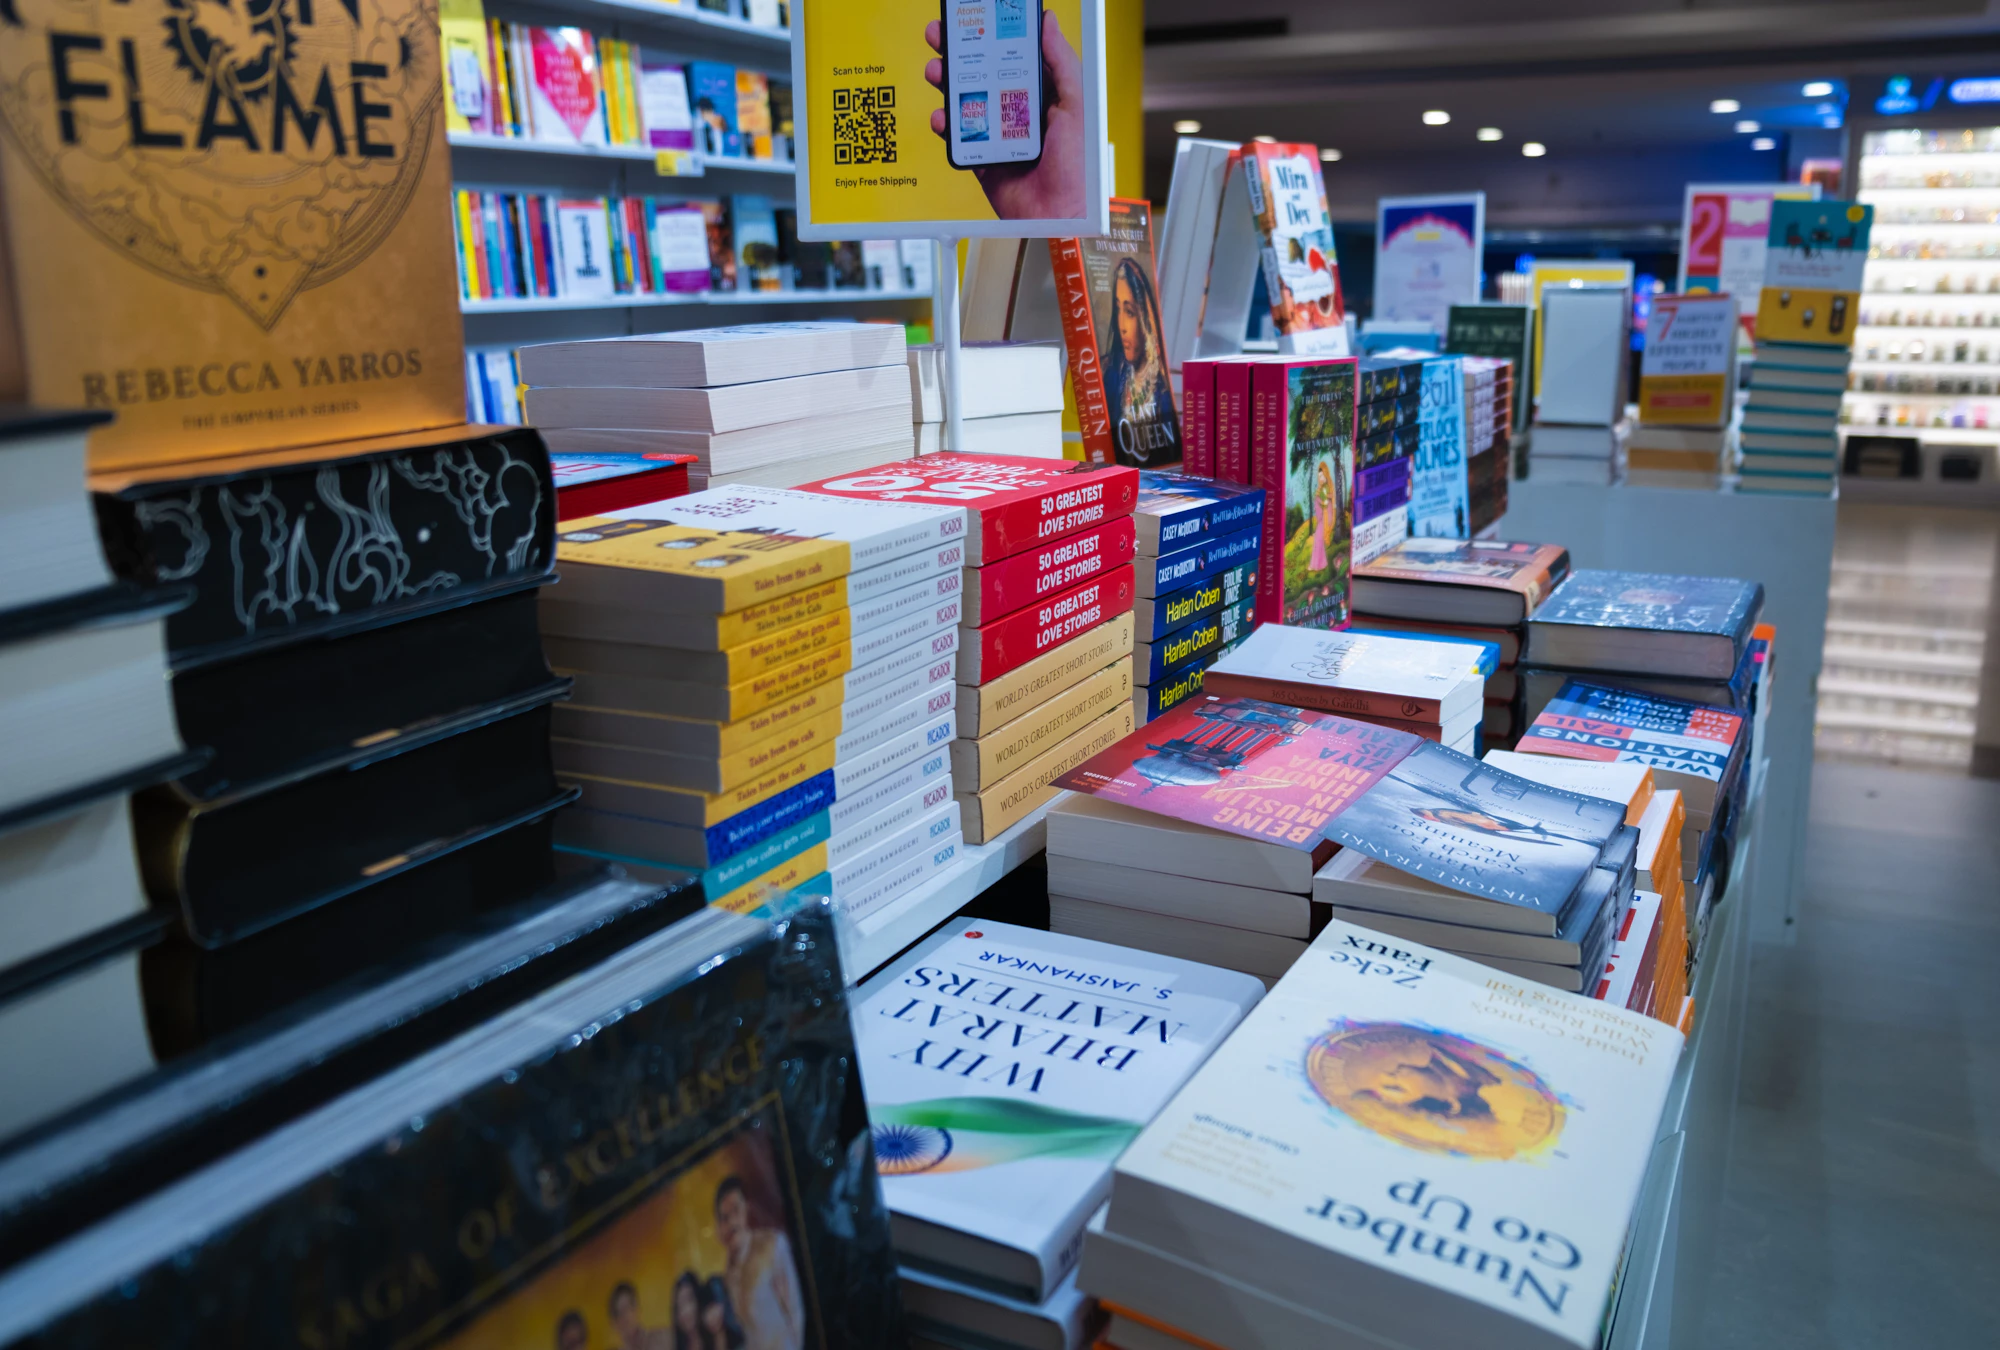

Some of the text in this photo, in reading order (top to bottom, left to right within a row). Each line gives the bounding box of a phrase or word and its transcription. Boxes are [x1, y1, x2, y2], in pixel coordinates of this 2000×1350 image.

[956, 6, 986, 16] Atomic
[958, 17, 984, 27] Habits
[832, 64, 885, 76] Scan to shop
[47, 31, 397, 158] FLAME
[961, 101, 986, 111] SILENT
[1001, 92, 1028, 102] IT ENDS
[1001, 102, 1020, 112] WITH
[962, 110, 986, 119] PATIENT
[835, 176, 917, 188] Enjoy Free Shipping
[1276, 165, 1309, 190] Mira
[1287, 202, 1311, 227] Dev
[1065, 272, 1091, 335] LAST
[83, 349, 422, 406] REBECCA YARROS
[1077, 346, 1109, 436] QUEEN
[1130, 402, 1157, 423] LAST
[1220, 392, 1229, 441] CHITRA
[1256, 392, 1265, 442] CHITRA
[1118, 417, 1176, 463] QUEEN
[1231, 393, 1240, 472] THE FOREST
[1041, 483, 1104, 515] 50 GREATEST
[1265, 393, 1277, 596] THE FOREST ENCHANTMENTS
[940, 516, 962, 537] PICADOR
[1038, 503, 1104, 538] LOVE STORIES
[1162, 523, 1177, 541] CASEY
[1355, 516, 1391, 551] GUEST LIST
[854, 530, 931, 560] TOSHIKAZU KAWAGUCHI
[1039, 534, 1100, 571] 50 GREATEST
[754, 574, 775, 593] Tales
[776, 570, 795, 586] from
[796, 567, 808, 582] the
[937, 574, 959, 596] PICADOR
[1036, 554, 1102, 594] LOVE STORIES
[1158, 563, 1173, 584] CASEY
[1223, 569, 1235, 589] FOOL
[1039, 585, 1100, 626] 50 GREATEST
[1166, 587, 1220, 624] Harlan Coben
[1224, 584, 1240, 606] ONCE
[857, 618, 929, 655] TOSHIKAZU KAWAGUCHI
[1036, 604, 1101, 649] LOVE STORIES
[1163, 626, 1217, 666] Harlan Coben
[995, 638, 1113, 712] WORLD'S GREATEST SHORT STORIES
[928, 690, 951, 714] PICADOR
[1271, 688, 1370, 711] 365 Quotes by Gandhi
[1588, 691, 1682, 713] POVERTY
[1597, 700, 1731, 728] PROSPERITY
[1689, 710, 1733, 721] AND
[927, 721, 950, 746] PICADOR
[995, 685, 1113, 764] WORLD'S GREATEST SHORT STORIES
[1310, 718, 1406, 749] SALAM
[1547, 716, 1624, 736] FAIL
[1585, 711, 1726, 740] THE ORIGINS
[1703, 724, 1728, 734] OF
[1317, 746, 1385, 771] ZIYA
[1359, 741, 1396, 760] US
[1434, 745, 1467, 758] SOLD
[1536, 727, 1717, 763] NATIONS
[841, 741, 919, 786] TOSHIKAZU KAWAGUCHI
[923, 756, 943, 777] PICADOR
[1000, 783, 1034, 812] WORLD'S
[1034, 760, 1069, 791] GREATEST
[1069, 745, 1091, 769] SHORT
[1092, 728, 1116, 753] STORIES
[1289, 754, 1372, 785] INDIA
[1474, 760, 1521, 783] COPIES
[1623, 755, 1712, 776] WHY
[834, 773, 913, 822] TOSHIKAZU KAWAGUCHI
[923, 784, 947, 809] PICADOR
[1258, 764, 1359, 799] HINDU
[1201, 784, 1330, 827] MUSLIM
[1305, 791, 1344, 813] IN
[728, 824, 754, 844] Before
[1213, 805, 1315, 843] BEING
[1409, 817, 1521, 863] Meaning
[717, 863, 745, 885] Before
[746, 854, 759, 868] the
[760, 841, 782, 862] coffee
[800, 824, 816, 843] cold
[933, 845, 954, 866] PICADOR
[1338, 829, 1423, 871] FRANKL
[1385, 822, 1528, 876] Search For
[1409, 844, 1485, 877] Man's
[1451, 874, 1541, 906] VIKTOR
[1329, 950, 1428, 990] Zeke
[1343, 933, 1435, 974] Faux
[978, 950, 1173, 1000] S. JAISHANKAR
[905, 965, 1189, 1045] MATTERS
[1485, 977, 1655, 1040] Staggering Fall
[1487, 991, 1650, 1053] Wild Rise and
[881, 997, 1142, 1073] BHARAT
[1572, 1031, 1647, 1066] Inside
[891, 1039, 1045, 1094] WHY
[536, 1036, 766, 1208] EXCELLENCE
[1387, 1178, 1583, 1272] Go Up
[1306, 1194, 1570, 1317] Number
